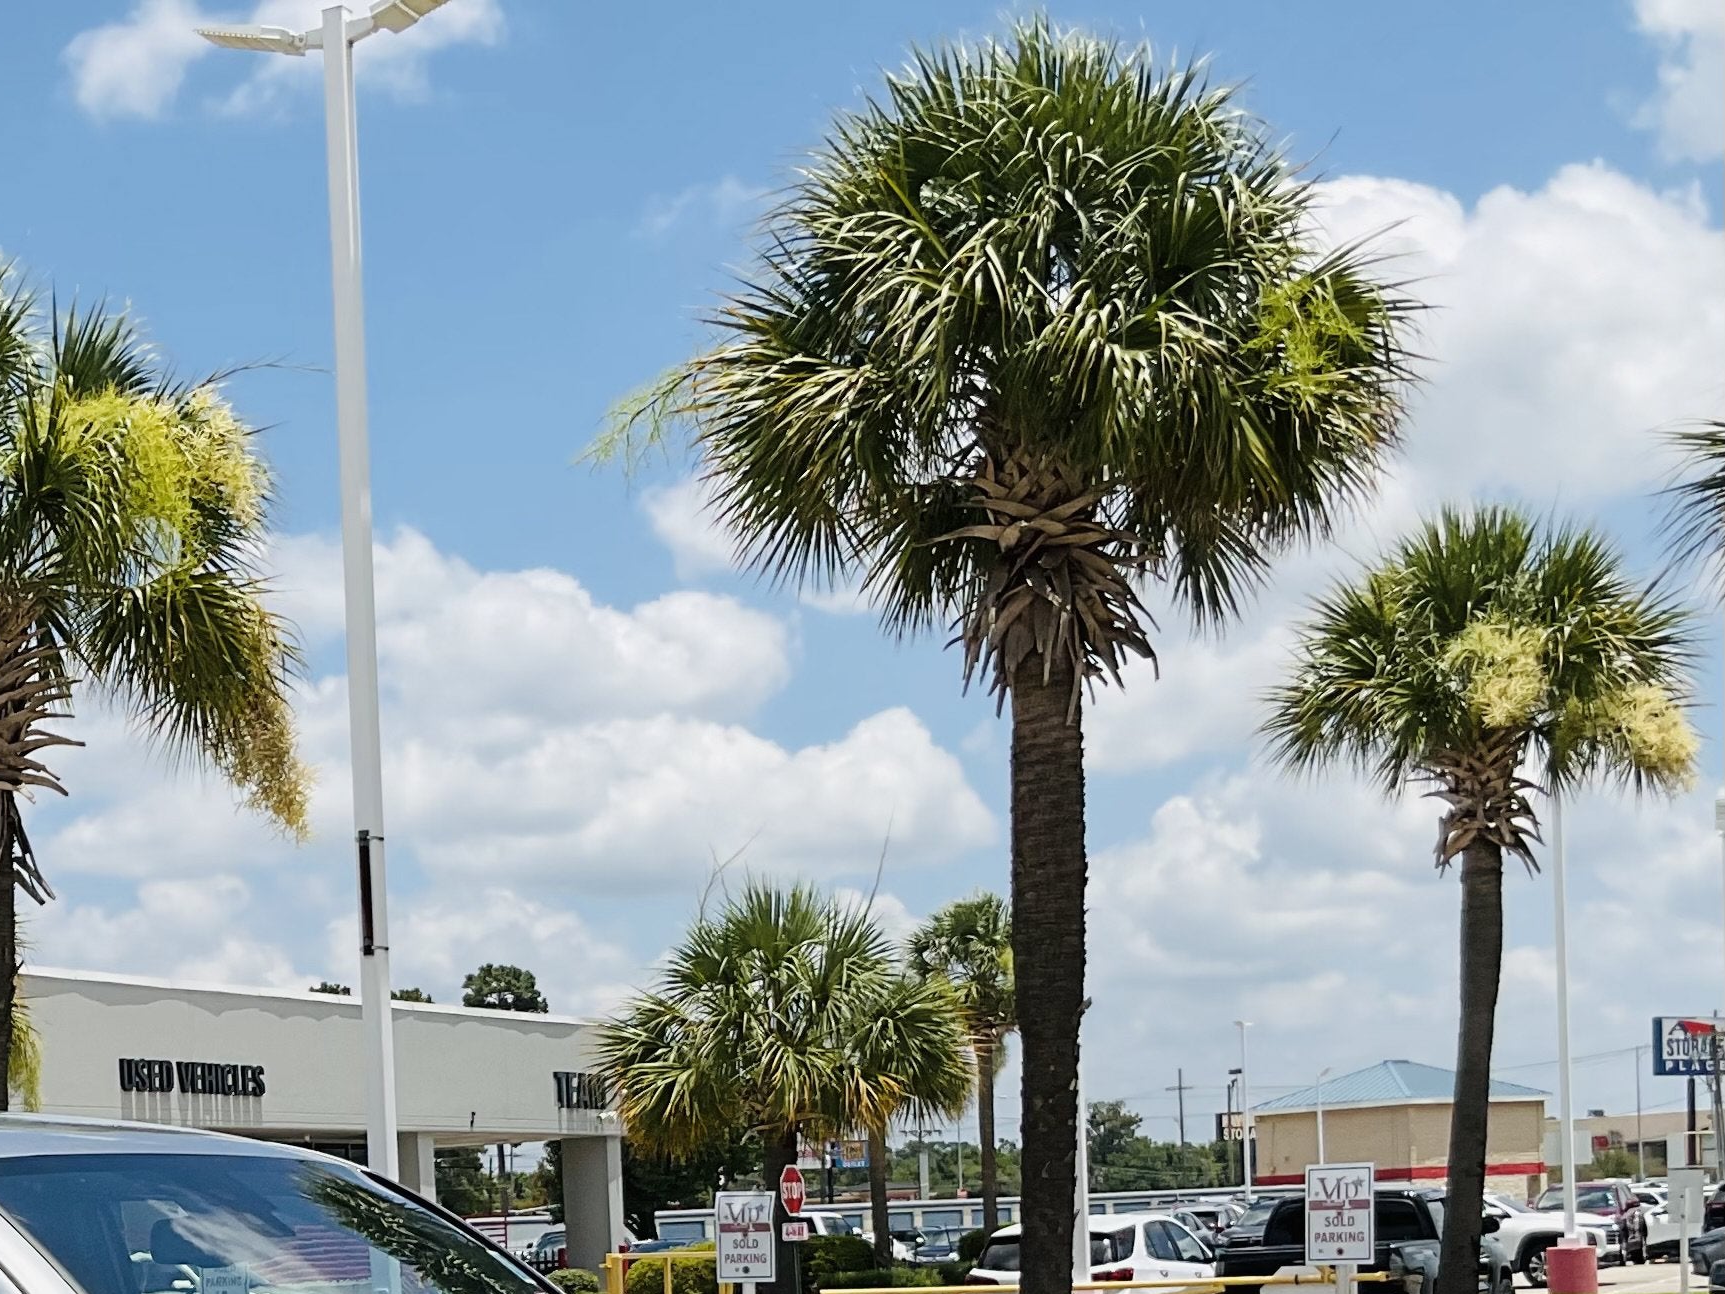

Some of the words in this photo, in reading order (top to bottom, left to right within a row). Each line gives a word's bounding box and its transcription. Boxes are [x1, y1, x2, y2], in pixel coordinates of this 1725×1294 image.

[119, 1058, 174, 1092] USED
[176, 1061, 266, 1097] VEHICLES
[782, 1182, 803, 1200] STOP
[1324, 1216, 1355, 1228] SOLD
[1314, 1231, 1365, 1243] PARKING
[732, 1238, 759, 1249] SOLD
[724, 1253, 767, 1264] PARKING
